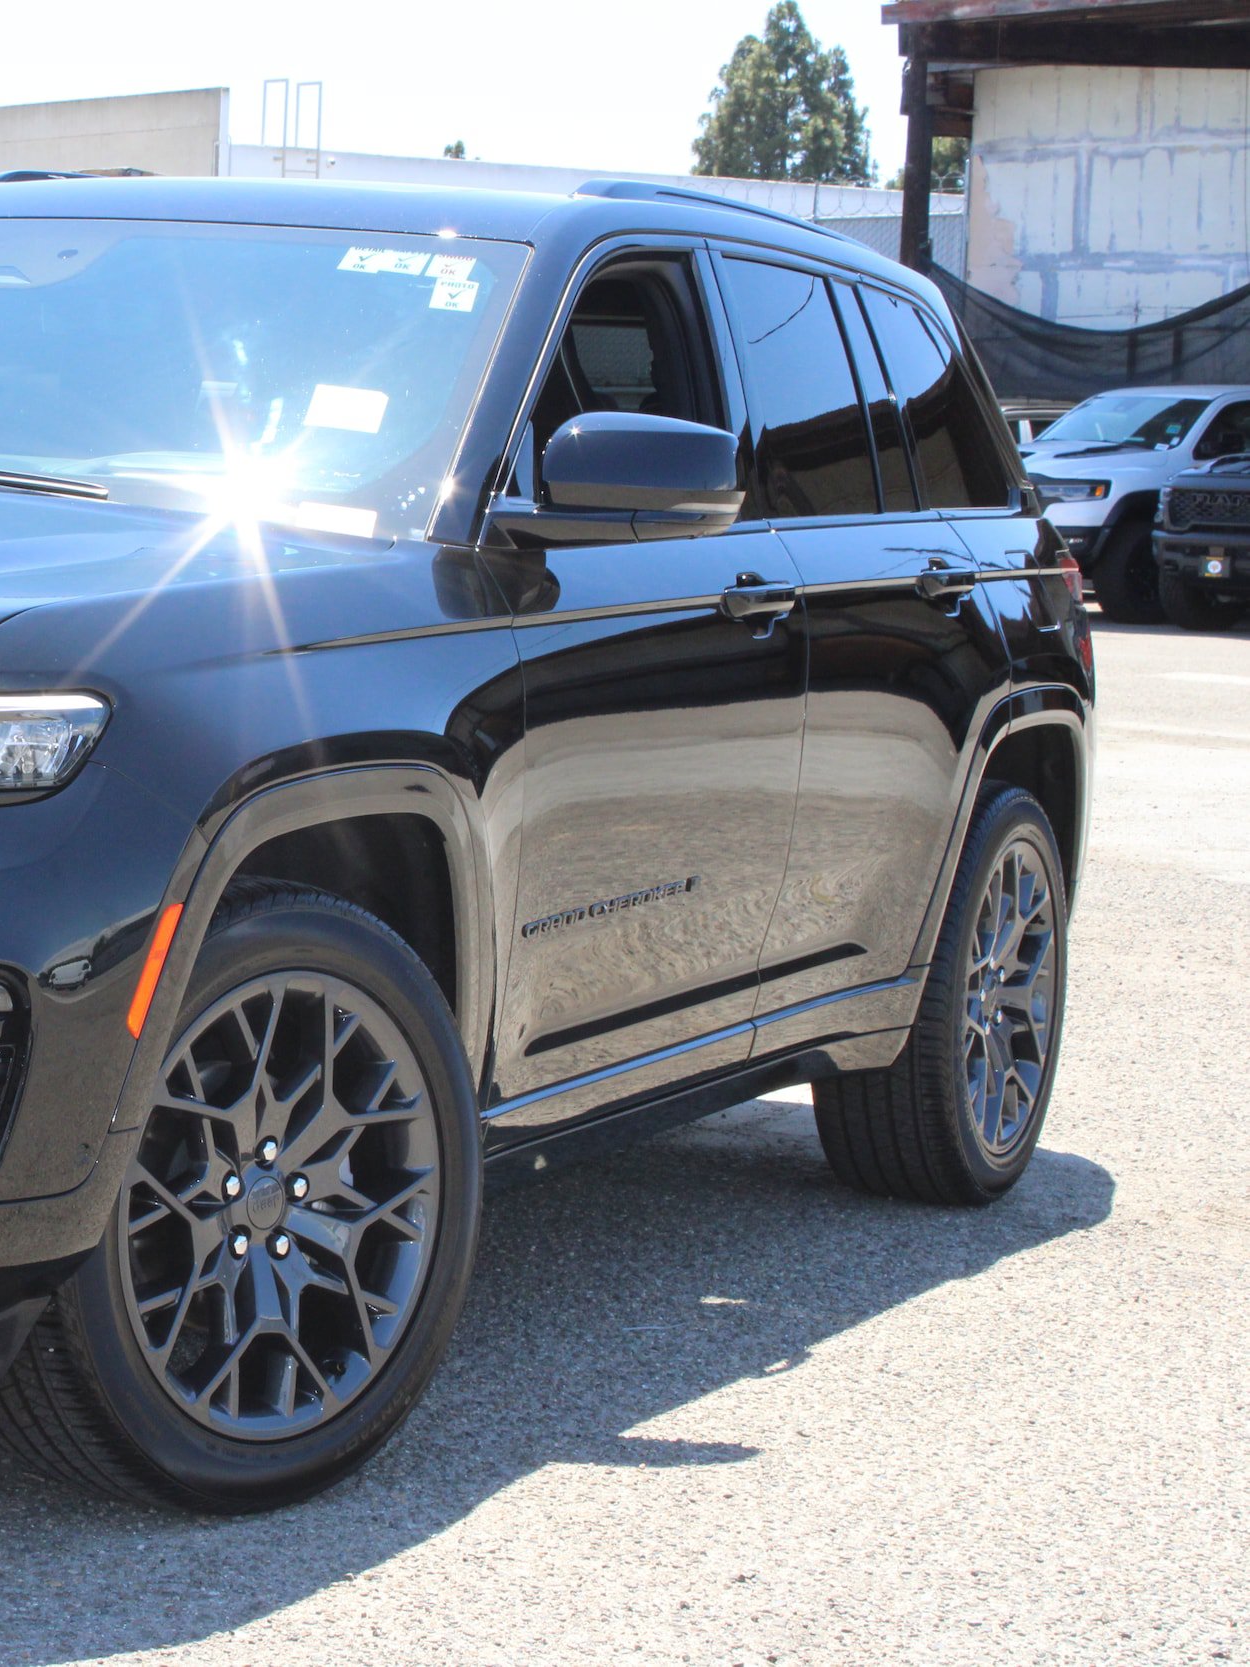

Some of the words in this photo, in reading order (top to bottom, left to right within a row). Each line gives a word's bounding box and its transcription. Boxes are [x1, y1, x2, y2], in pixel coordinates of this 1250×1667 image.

[440, 281, 475, 290] PHOTO
[521, 907, 587, 938] GRAND
[588, 875, 702, 918] CHEROKEE
